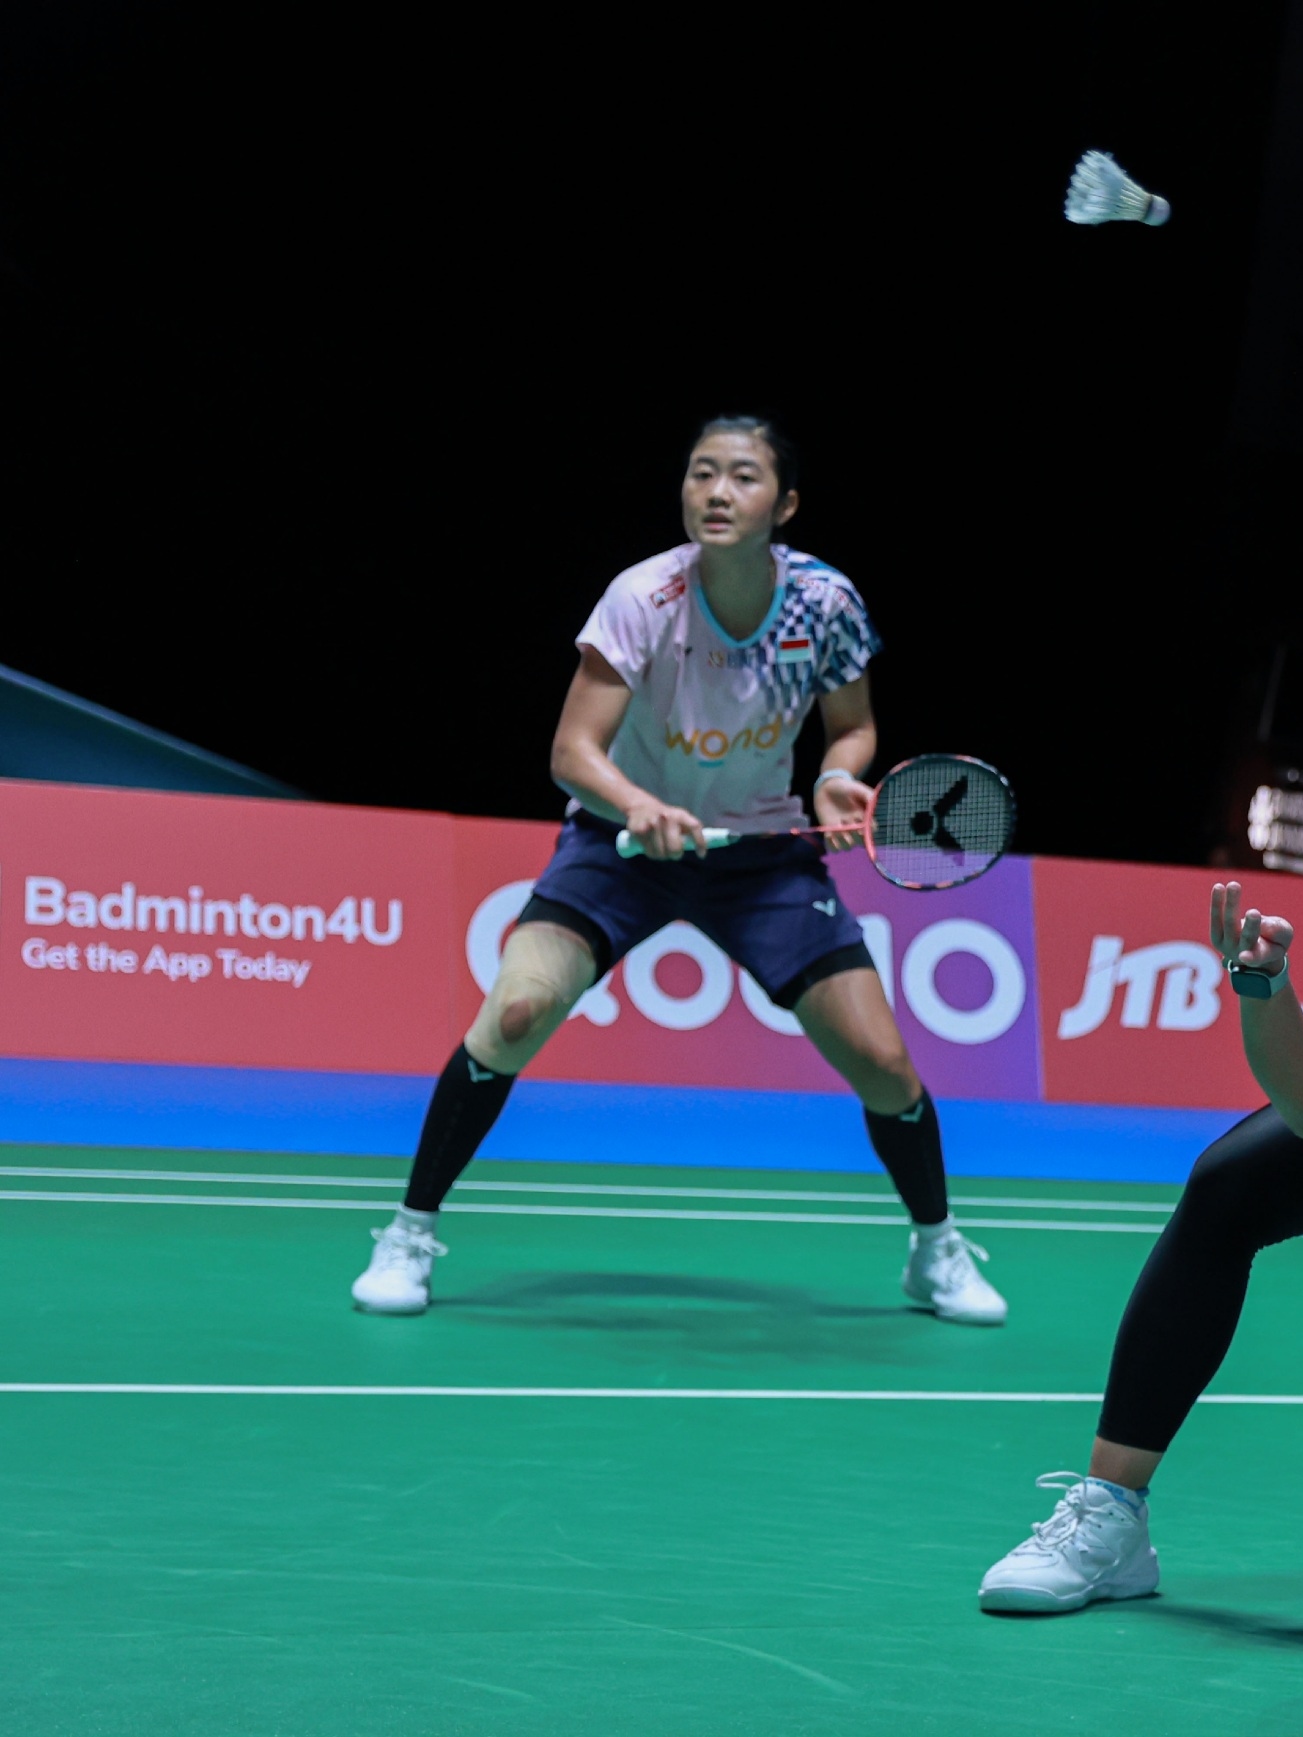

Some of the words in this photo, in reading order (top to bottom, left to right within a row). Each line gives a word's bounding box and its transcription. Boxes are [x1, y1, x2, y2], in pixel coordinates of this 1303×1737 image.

[24, 875, 403, 946] Badminton4U
[22, 938, 80, 971] Get
[86, 941, 138, 974] the
[144, 944, 211, 982] App
[216, 948, 312, 988] Today
[1057, 934, 1222, 1040] JTB
